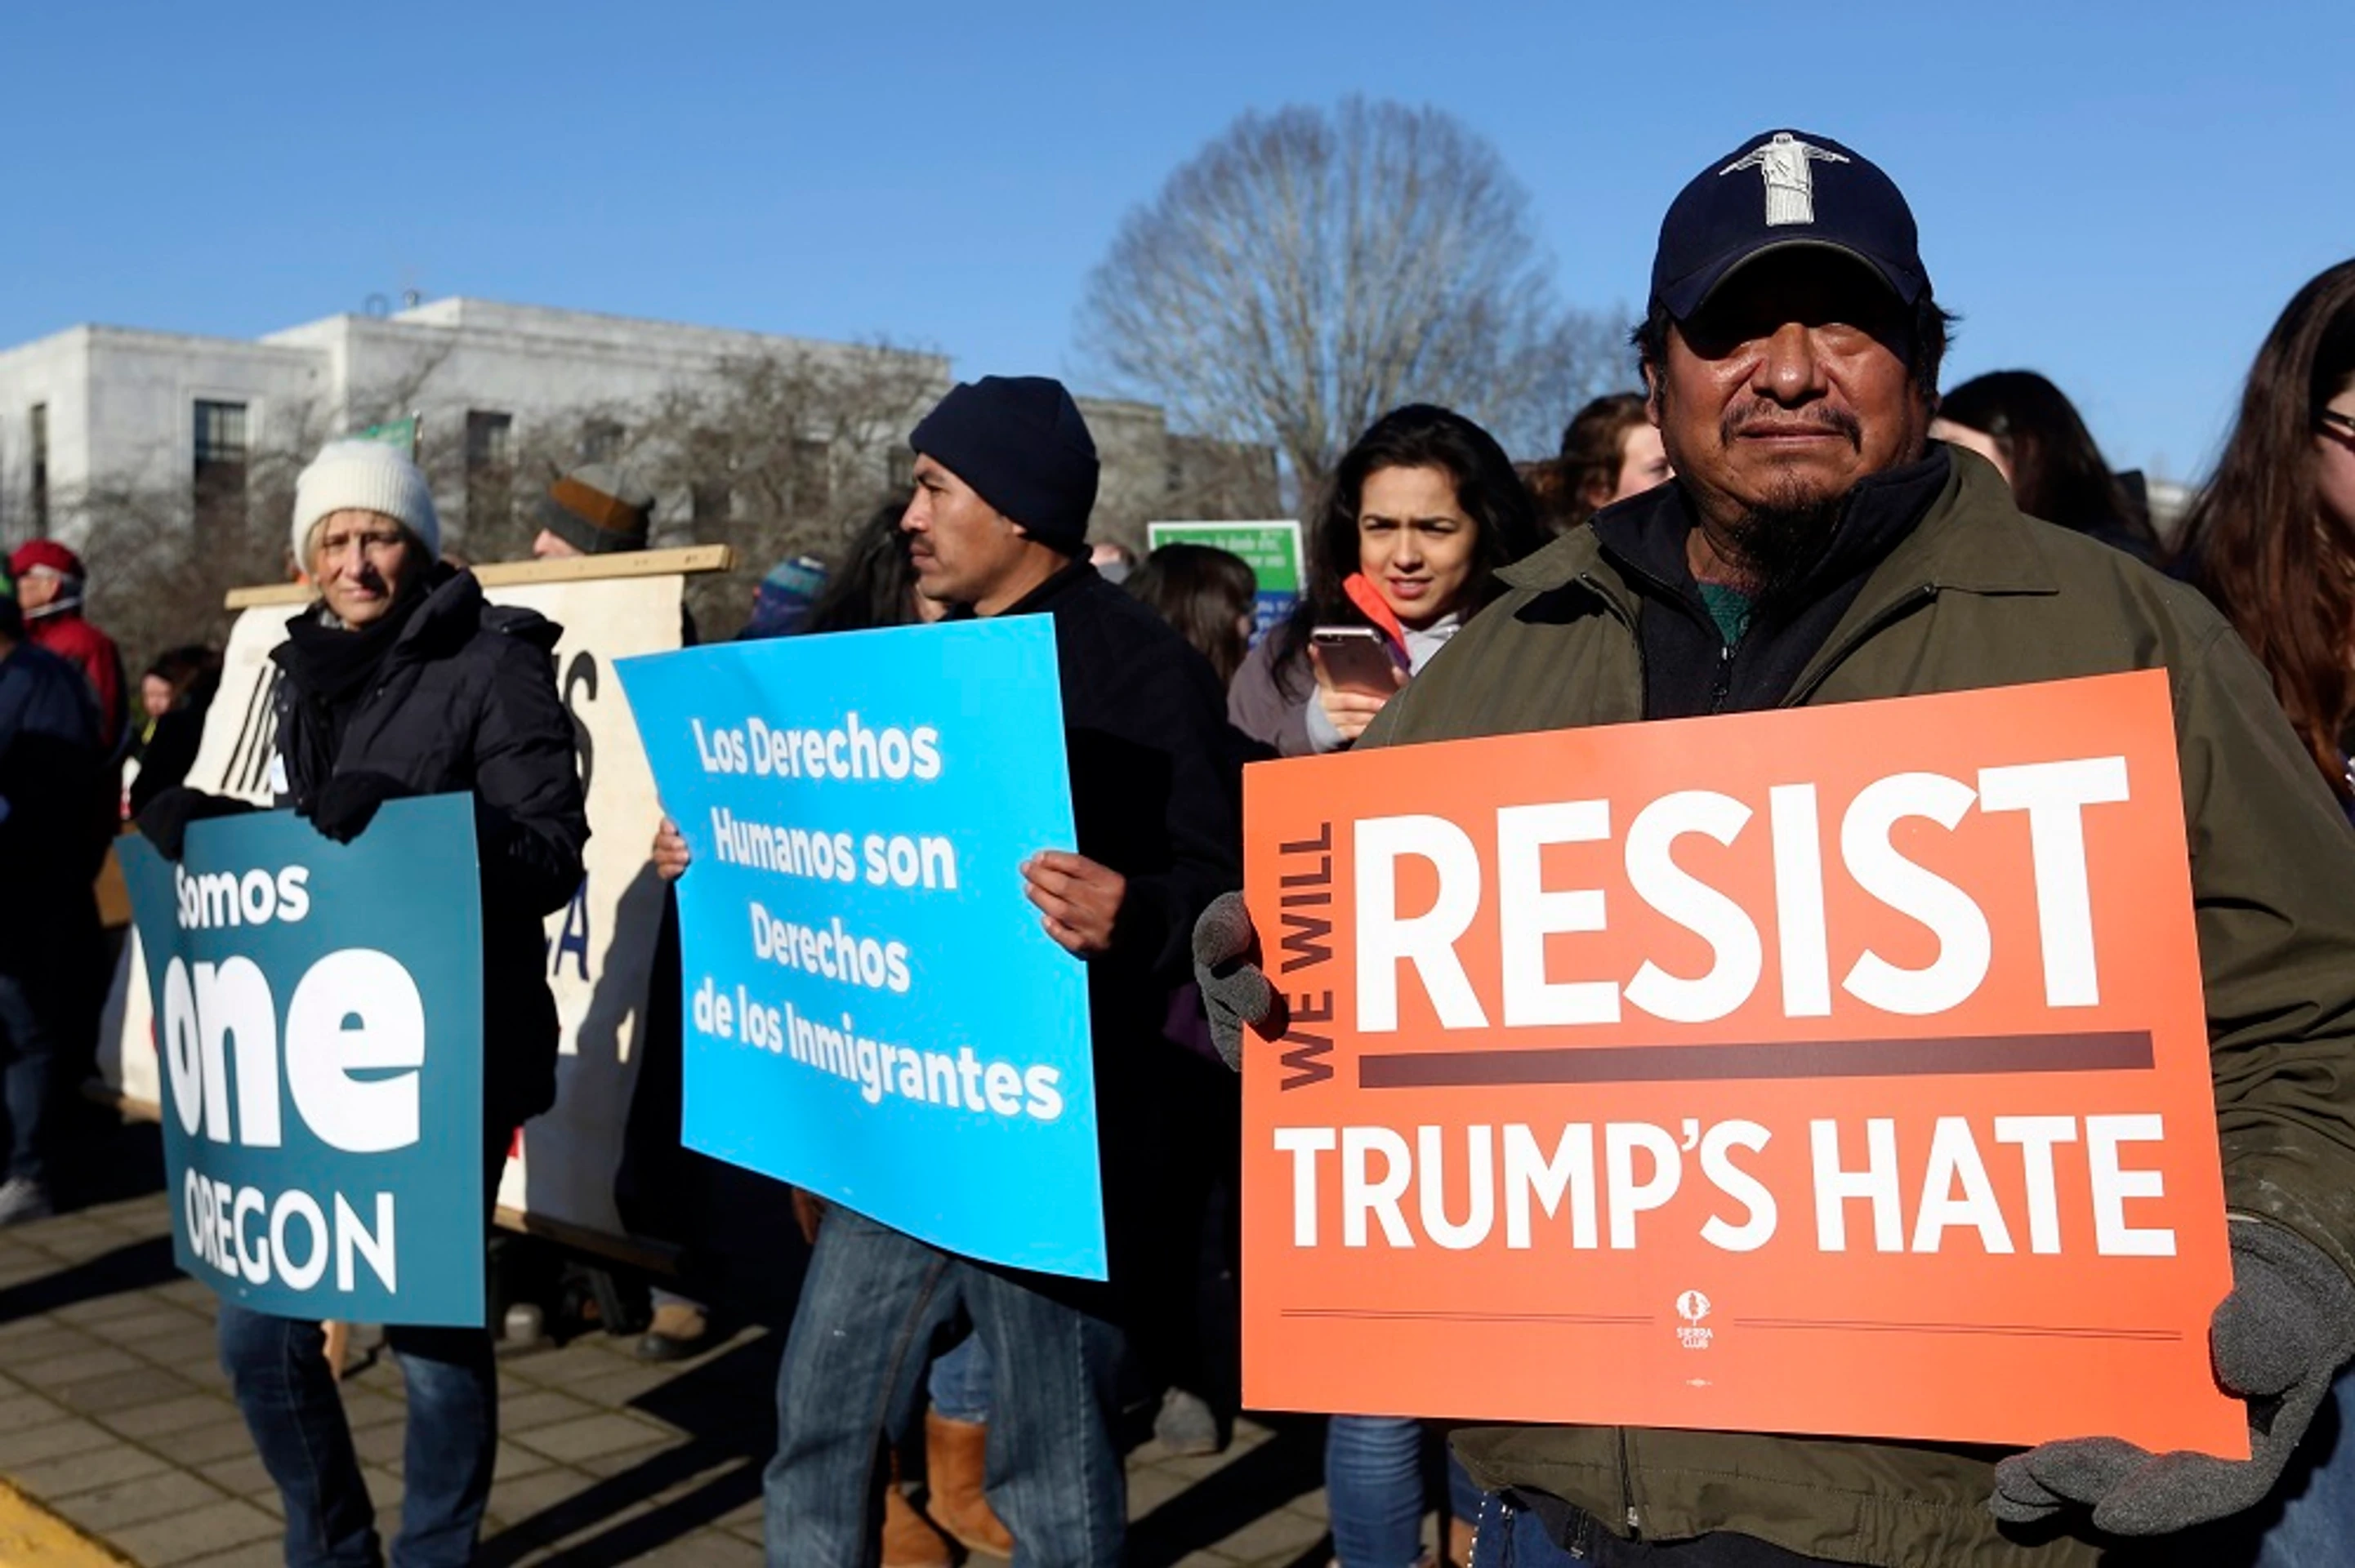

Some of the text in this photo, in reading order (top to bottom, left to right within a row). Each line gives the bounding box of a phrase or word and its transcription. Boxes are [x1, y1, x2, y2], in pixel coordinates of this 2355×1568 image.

[692, 712, 941, 780] Los Derechos
[711, 807, 957, 889] Humanos son
[1354, 755, 2130, 1032] RESIST
[749, 902, 911, 993] Derechos
[1279, 822, 1335, 1092] WE WILL
[164, 947, 426, 1153] one
[693, 978, 1064, 1121] de los Inmigrantes
[185, 1168, 397, 1294] OREGON
[1273, 1113, 2177, 1256] TRUMP'S HATE
